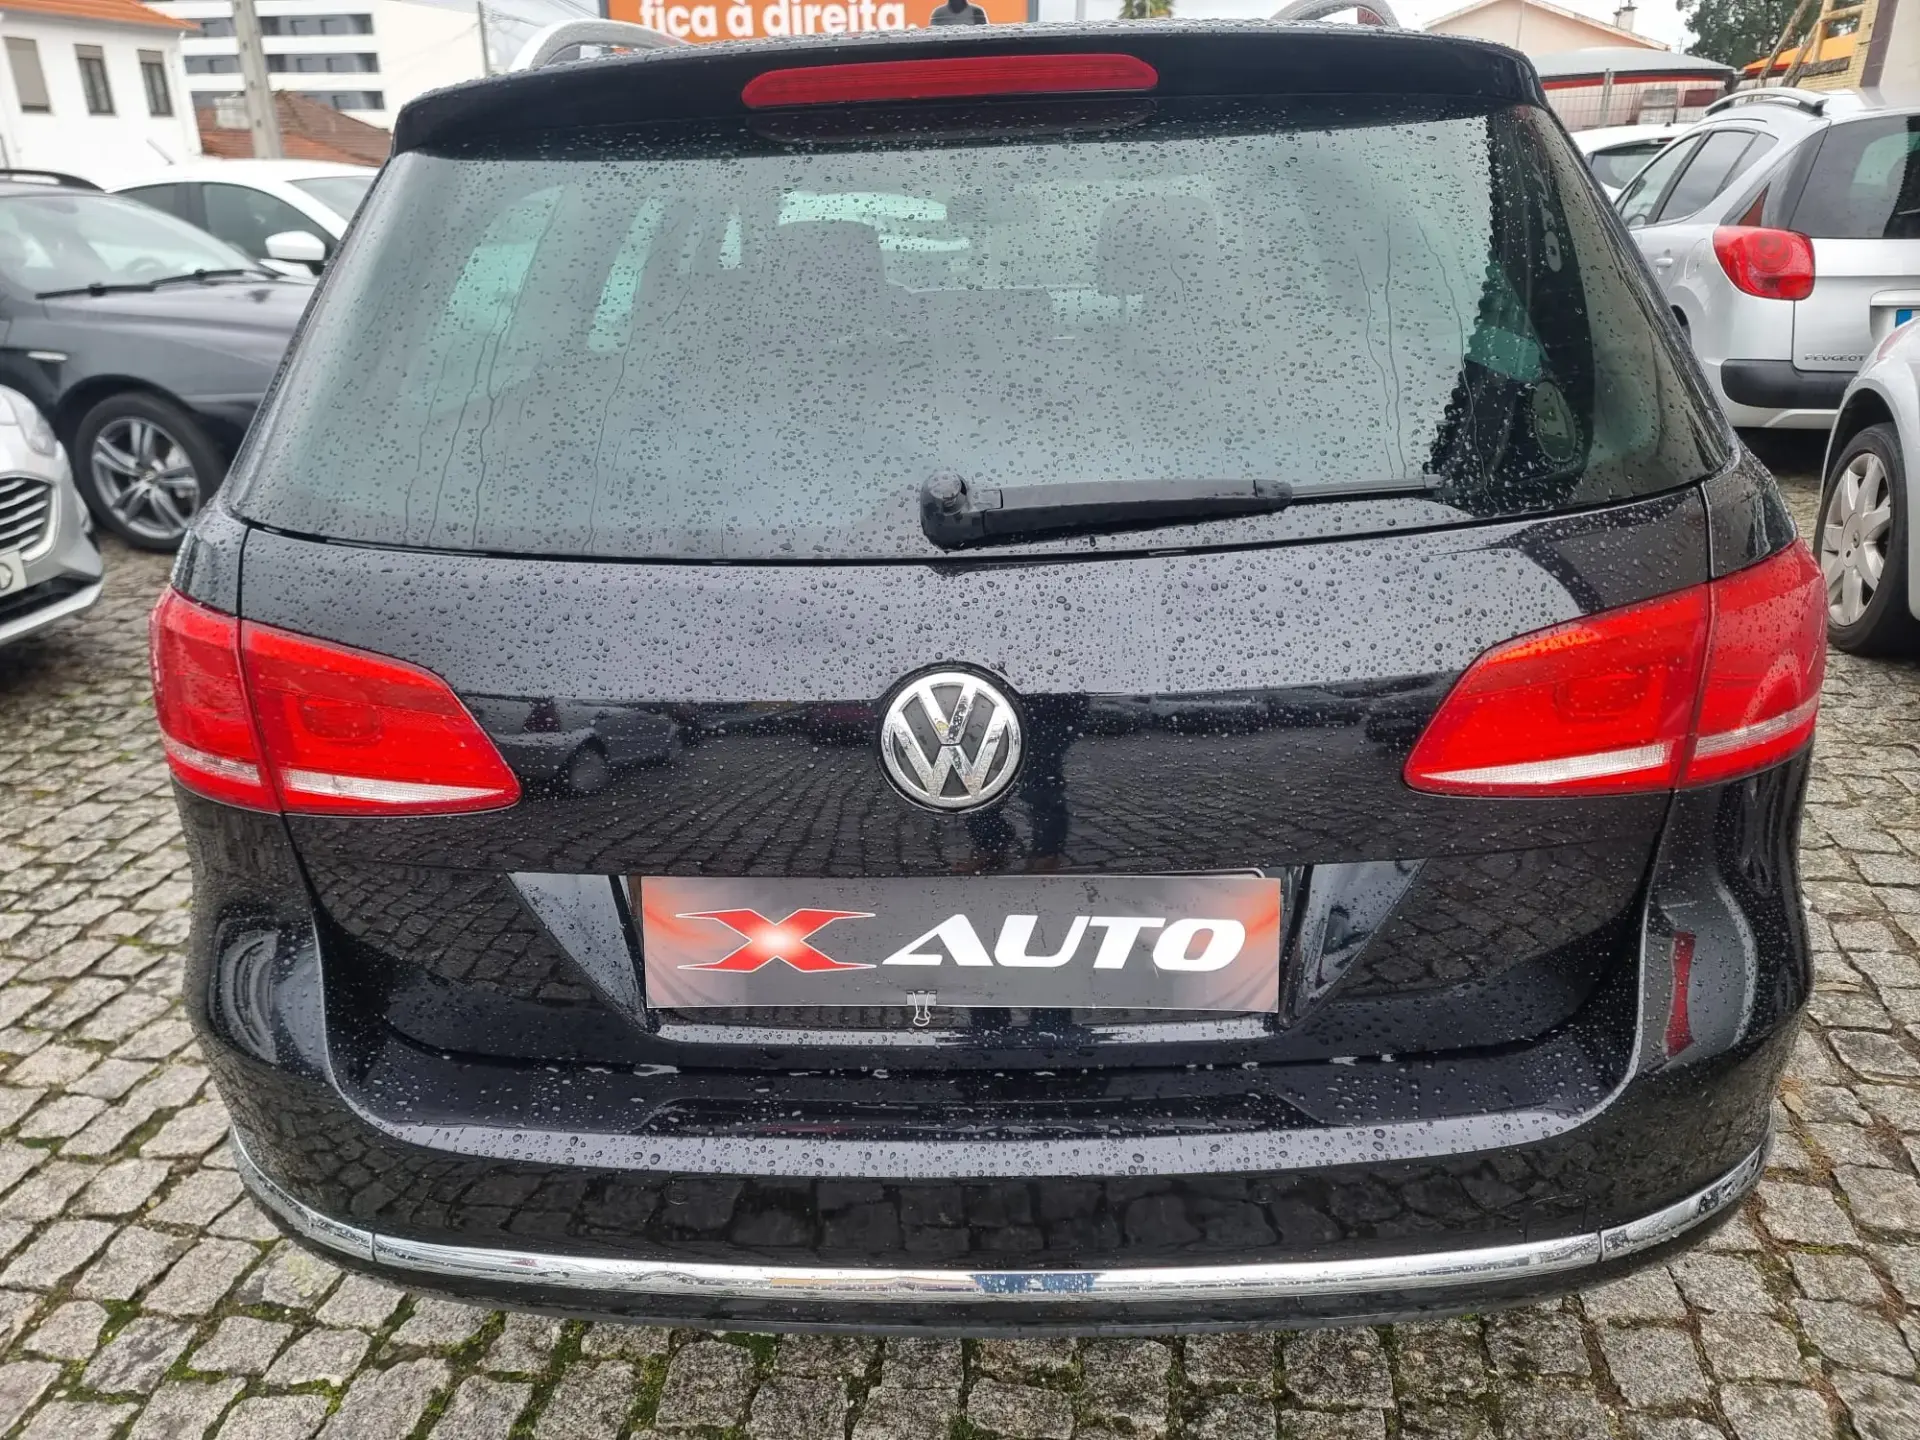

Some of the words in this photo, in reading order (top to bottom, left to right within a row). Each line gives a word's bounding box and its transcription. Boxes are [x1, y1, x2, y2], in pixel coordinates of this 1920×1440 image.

[641, 0, 718, 37] fica
[726, 0, 754, 37] à
[763, 0, 919, 36] direita.
[1803, 353, 1868, 362] PEUGEOT
[883, 914, 1246, 971] AUTO
